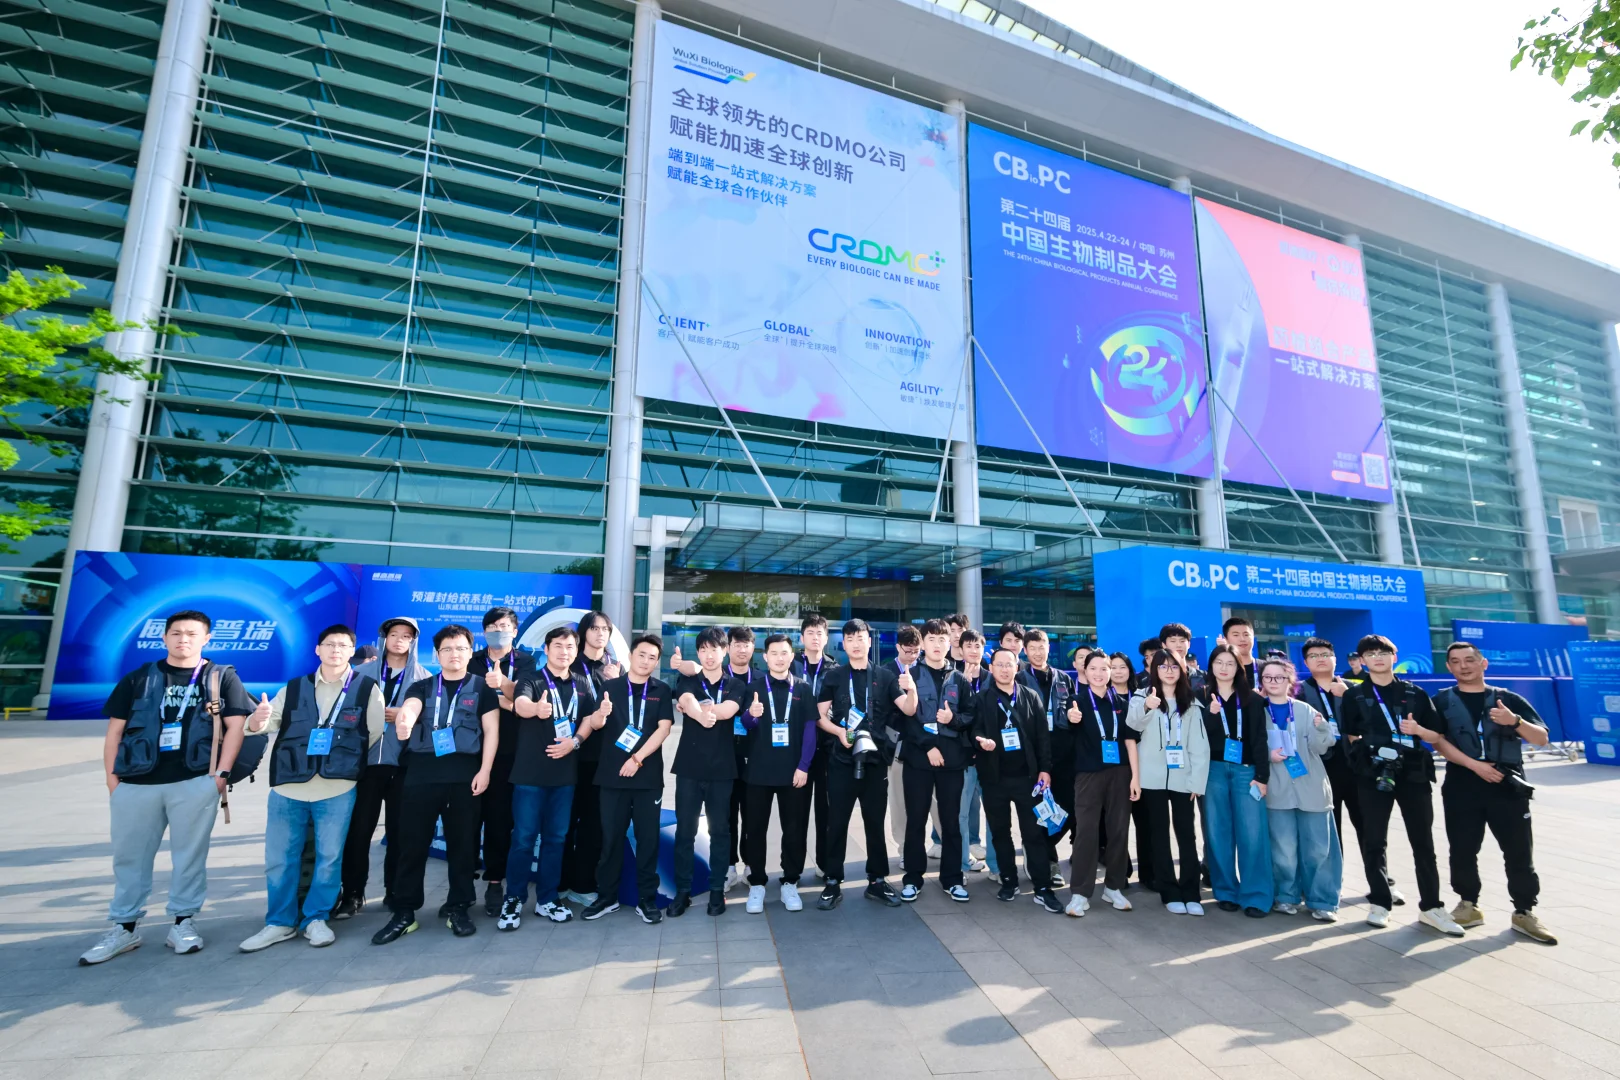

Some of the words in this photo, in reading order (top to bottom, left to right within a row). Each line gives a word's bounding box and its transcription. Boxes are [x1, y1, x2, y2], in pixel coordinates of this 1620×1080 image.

[673, 47, 698, 62] WuXi
[701, 56, 744, 76] Biologics
[669, 114, 854, 184] 赋能加速全球创新
[672, 87, 906, 172] 全球领先的CRDMO公司
[667, 147, 817, 198] 端到端一站式解决方案
[667, 166, 788, 208] 赋能全球合作伙伴
[1000, 197, 1071, 232] 第二十四届
[1076, 224, 1130, 247] 2025.4.22-24
[807, 254, 837, 268] EVERY
[840, 261, 881, 278] BIOLOGIC
[884, 271, 901, 283] CAN
[904, 276, 915, 286] BE
[917, 278, 941, 291] MADE
[1001, 221, 1177, 289] 中国生物制品大会
[1003, 249, 1015, 259] THE
[1017, 252, 1032, 262] 24TH
[1033, 257, 1052, 268] CHINA
[1054, 263, 1089, 278] BIOLOGICAL
[1090, 272, 1120, 286] PRODUCTS
[1121, 280, 1143, 292] ANNUAL
[1144, 286, 1178, 300] CONFERENCE
[1275, 355, 1377, 391] 一站式解决方案
[1246, 564, 1406, 594] 第二十四届中国生物制品大会
[1247, 586, 1258, 594] THE
[1260, 587, 1274, 595] 24TH
[1275, 588, 1292, 596] CHINA
[1293, 590, 1326, 598] BIOLOGICAL
[1326, 592, 1355, 600] PRODUCTS
[801, 604, 821, 612] HALL
